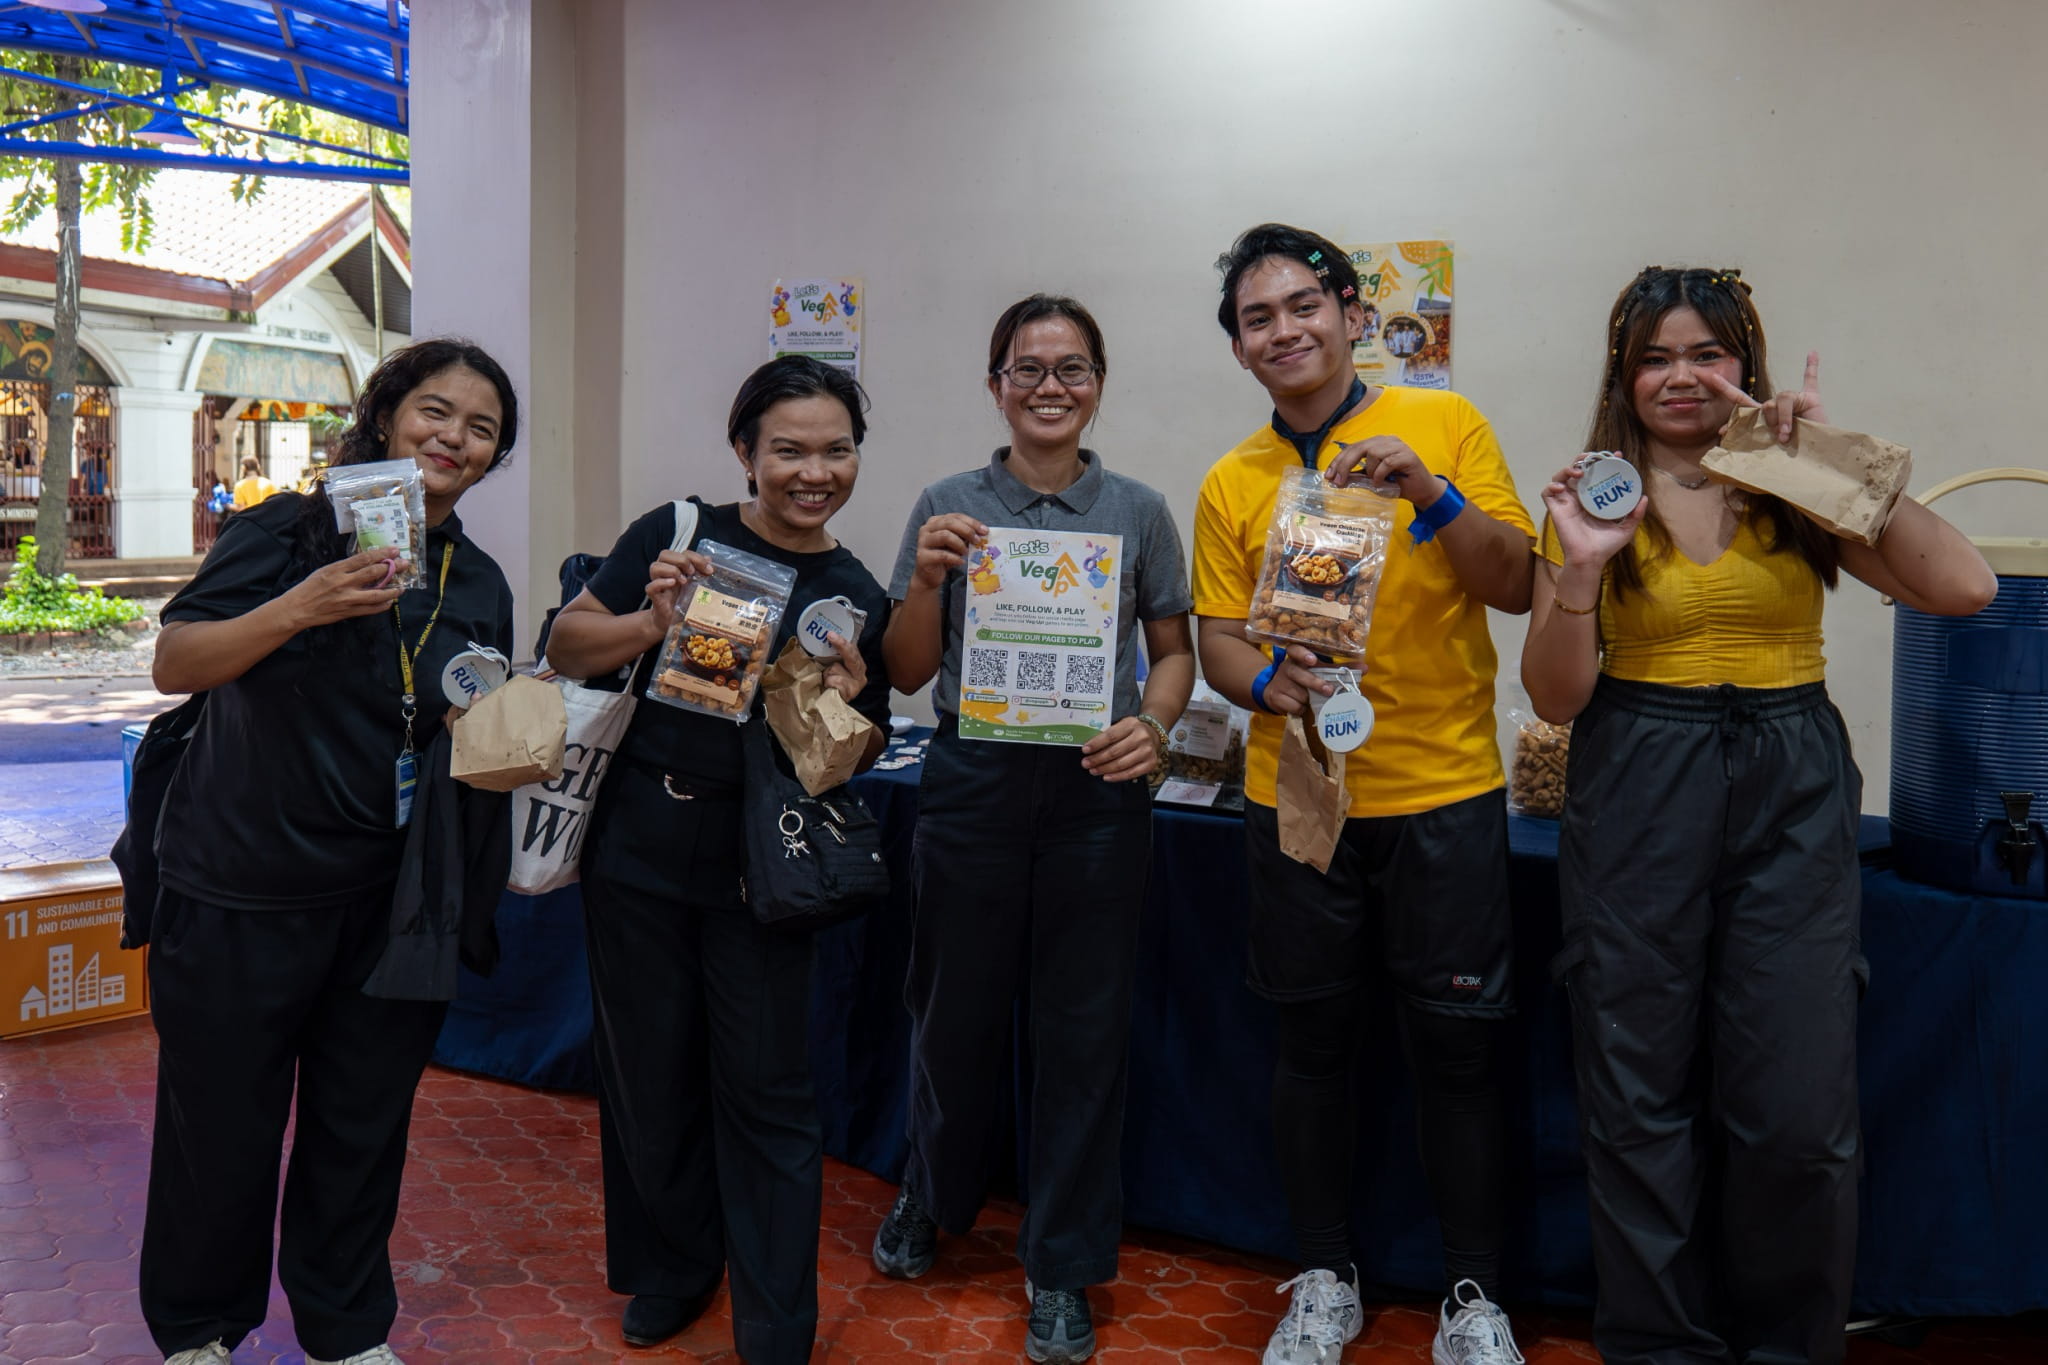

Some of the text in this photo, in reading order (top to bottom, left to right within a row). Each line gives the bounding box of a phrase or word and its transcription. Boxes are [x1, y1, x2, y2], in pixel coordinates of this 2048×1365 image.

[1359, 274, 1381, 297] eg
[801, 299, 825, 320] Veg
[1593, 480, 1632, 510] RUN
[1009, 539, 1050, 556] Let's
[1020, 560, 1060, 590] Veg
[996, 603, 1015, 612] LIKE,
[1017, 604, 1054, 615] FOLLOW,
[1064, 607, 1085, 615] PLAY
[991, 632, 1023, 641] FOLLOW
[1042, 635, 1066, 643] PAGES
[1079, 638, 1098, 646] PLAY
[1325, 719, 1357, 738] RUN
[36, 900, 103, 920] SUSTAINABLE
[4, 910, 29, 940] 11
[36, 912, 122, 935] AND COMMUNITIE
